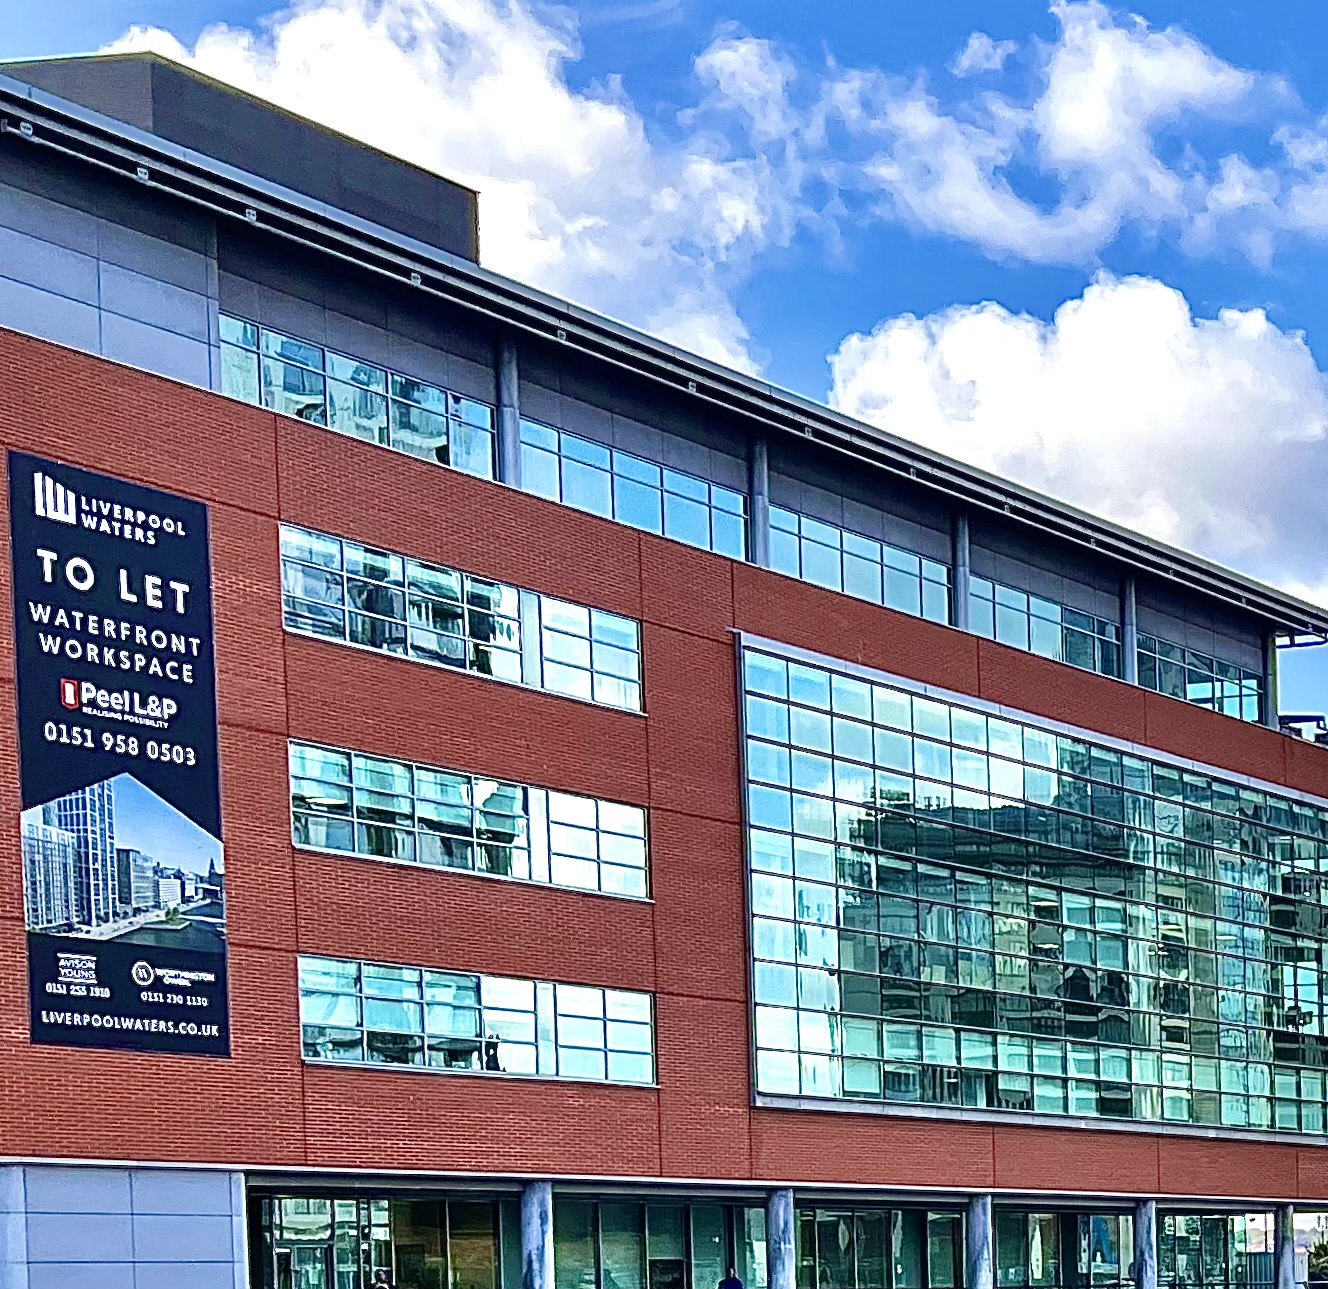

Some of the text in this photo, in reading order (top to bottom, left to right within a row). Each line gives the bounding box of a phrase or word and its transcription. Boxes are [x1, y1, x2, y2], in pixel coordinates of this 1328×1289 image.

[80, 495, 186, 536] LIVERPOOL
[80, 513, 156, 545] WATERS
[36, 548, 190, 614] TO LET
[28, 601, 201, 656] WATERFRONT
[38, 632, 194, 684] WORKSPACE
[81, 681, 178, 719] Peel L&P
[43, 721, 196, 766] 0151 958 0503
[41, 1010, 219, 1037] LIVERPOOLWATERS.CO.UK
